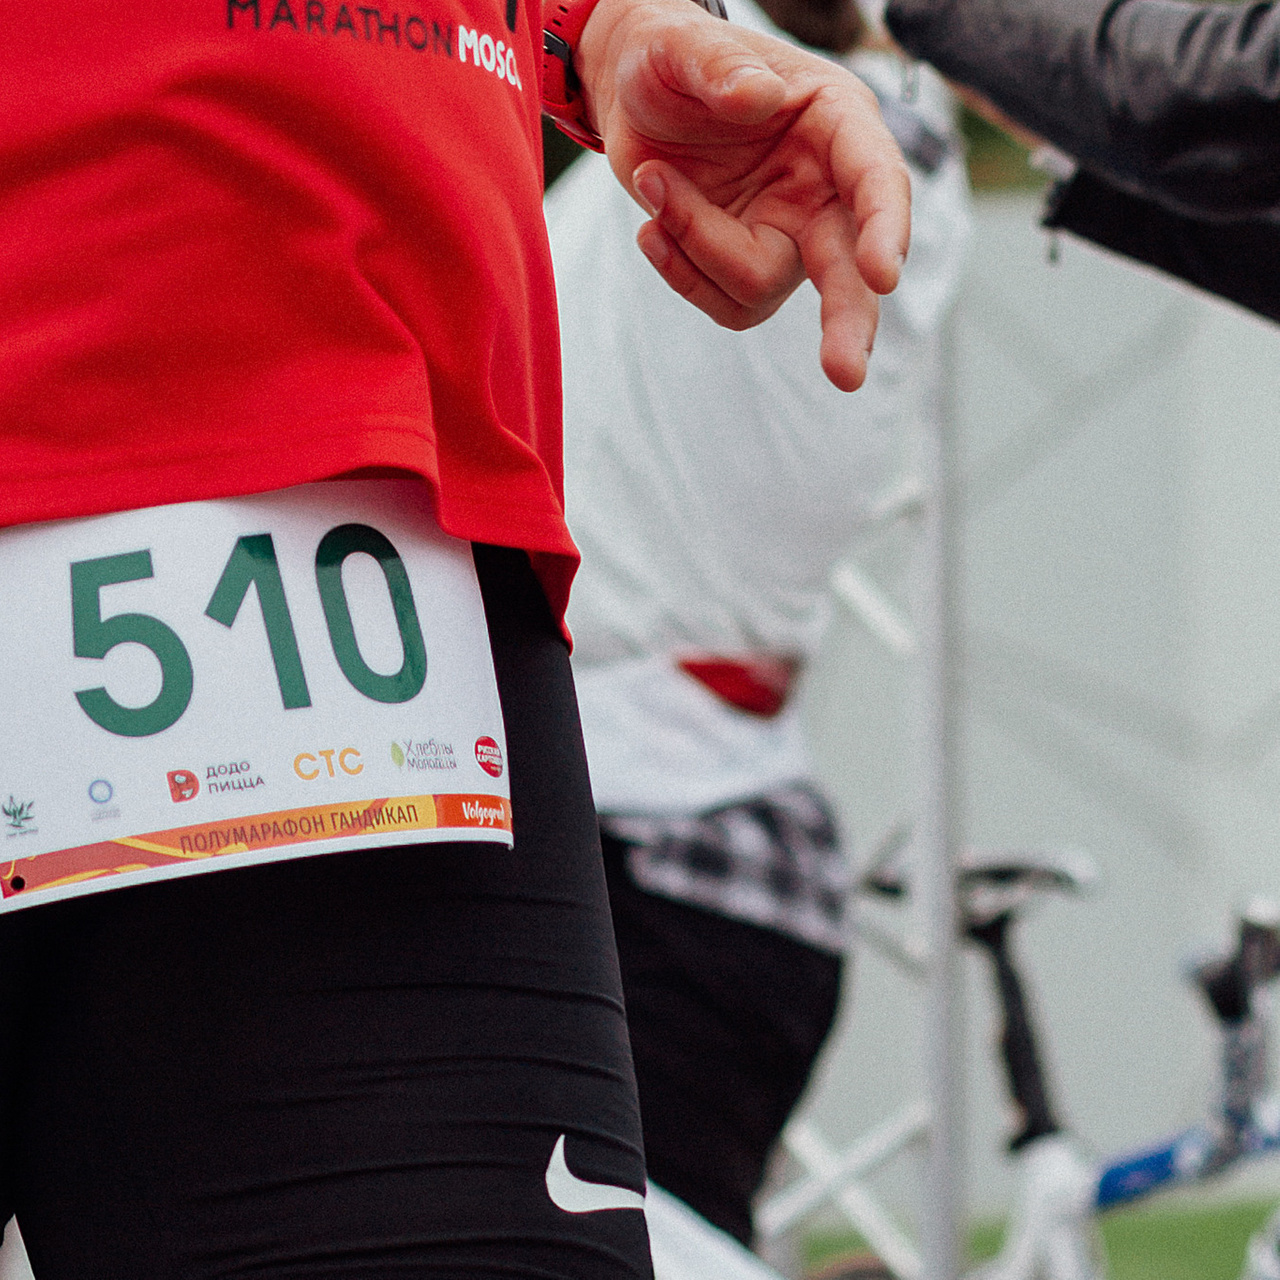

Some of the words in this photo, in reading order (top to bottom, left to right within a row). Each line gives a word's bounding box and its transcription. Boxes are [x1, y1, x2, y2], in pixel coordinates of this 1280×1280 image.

[70, 523, 427, 737] 510
[206, 761, 251, 780] ДОДО
[293, 747, 364, 781] СТС
[207, 776, 266, 795] ПИЦЦА
[179, 814, 326, 855] ПОЛУМАРАФОН
[330, 804, 419, 831] ГАНДИКАП
